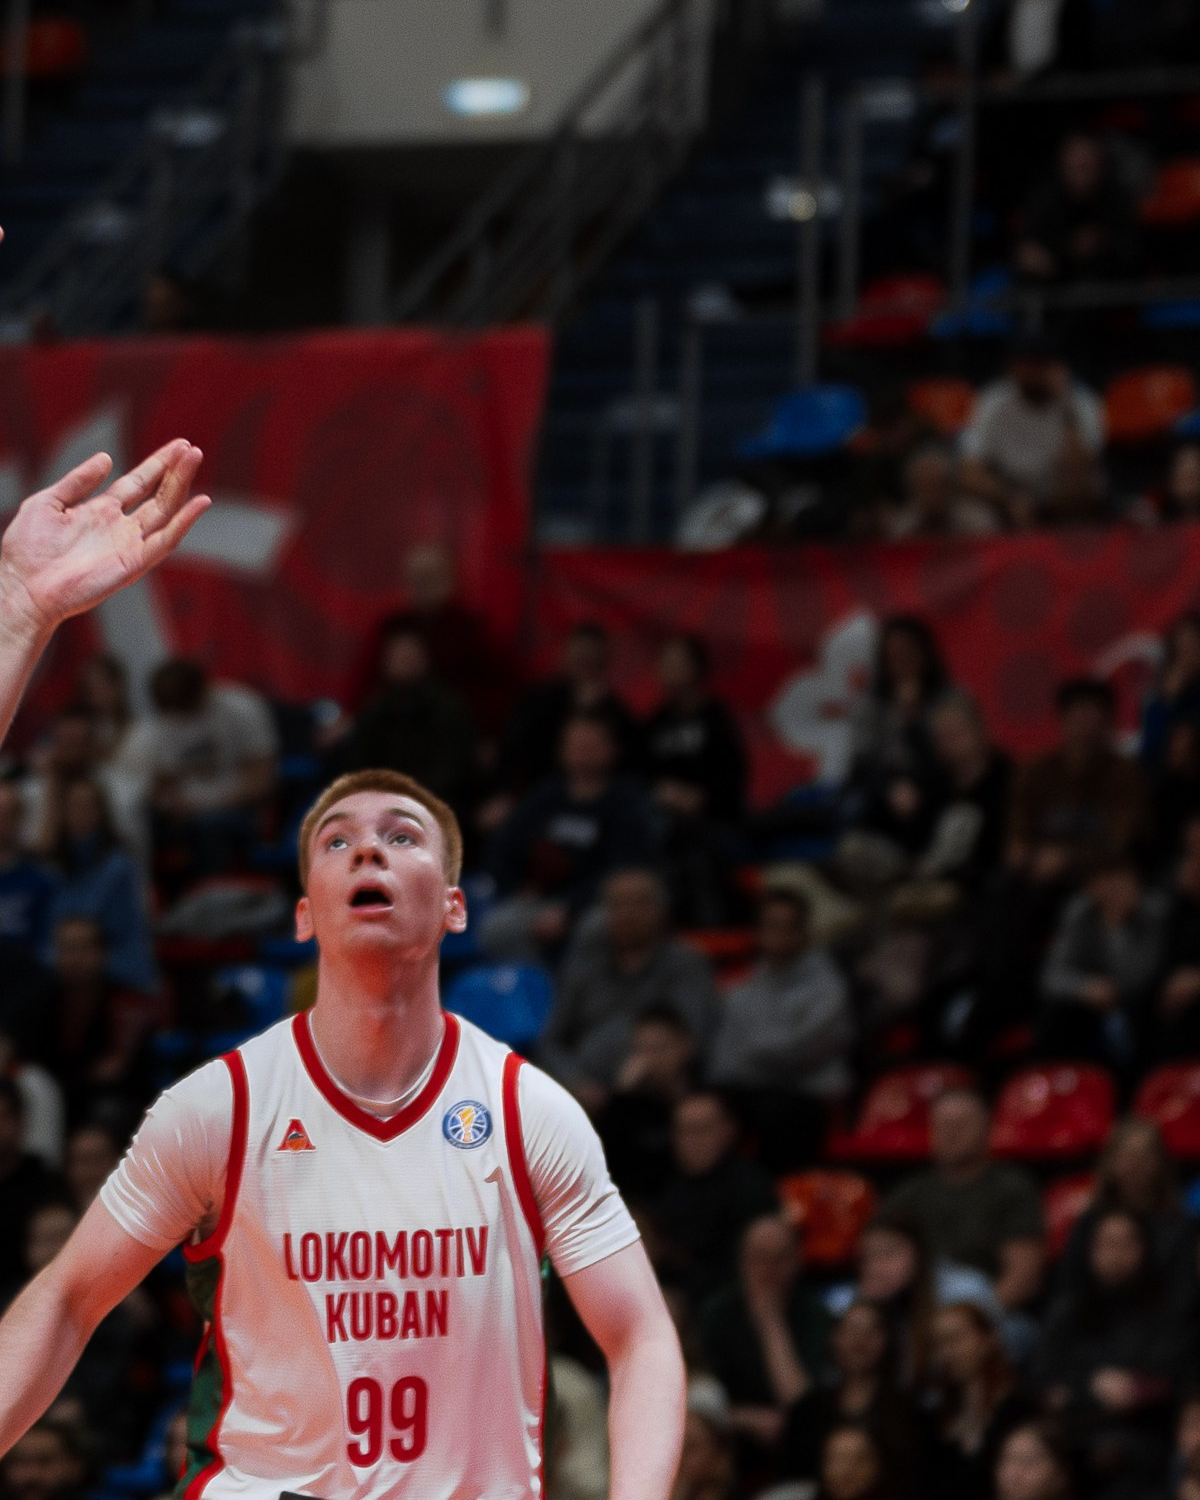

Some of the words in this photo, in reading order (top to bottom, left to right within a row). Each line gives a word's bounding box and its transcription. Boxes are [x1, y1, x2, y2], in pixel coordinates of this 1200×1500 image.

[283, 1225, 489, 1283] LOKOMOTIV
[325, 1289, 449, 1343] KUBAN
[346, 1375, 429, 1469] 99
